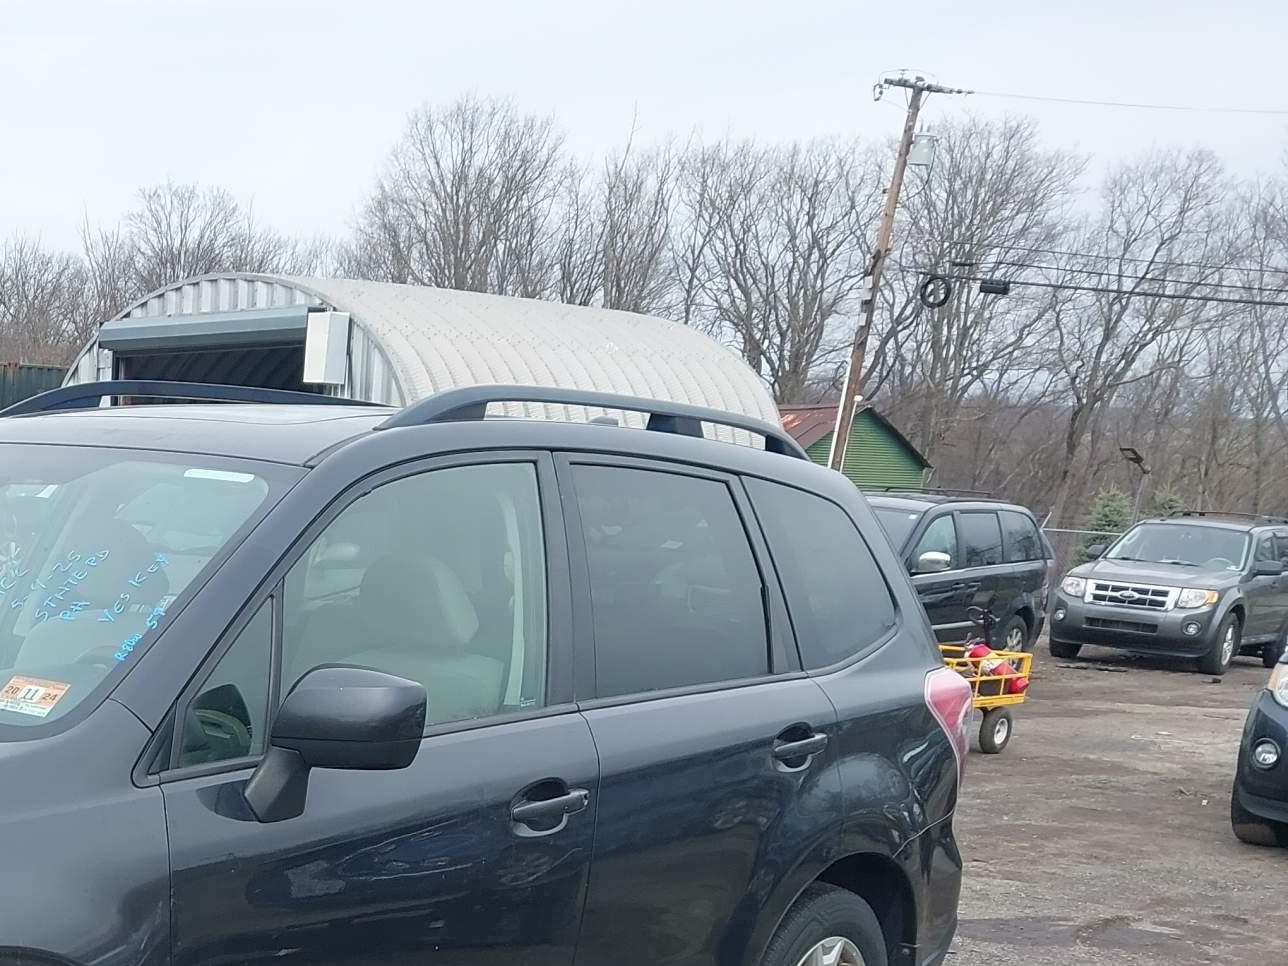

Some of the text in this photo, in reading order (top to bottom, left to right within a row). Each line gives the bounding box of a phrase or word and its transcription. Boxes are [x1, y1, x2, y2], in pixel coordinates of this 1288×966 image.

[5, 685, 58, 701] 20 11 24
